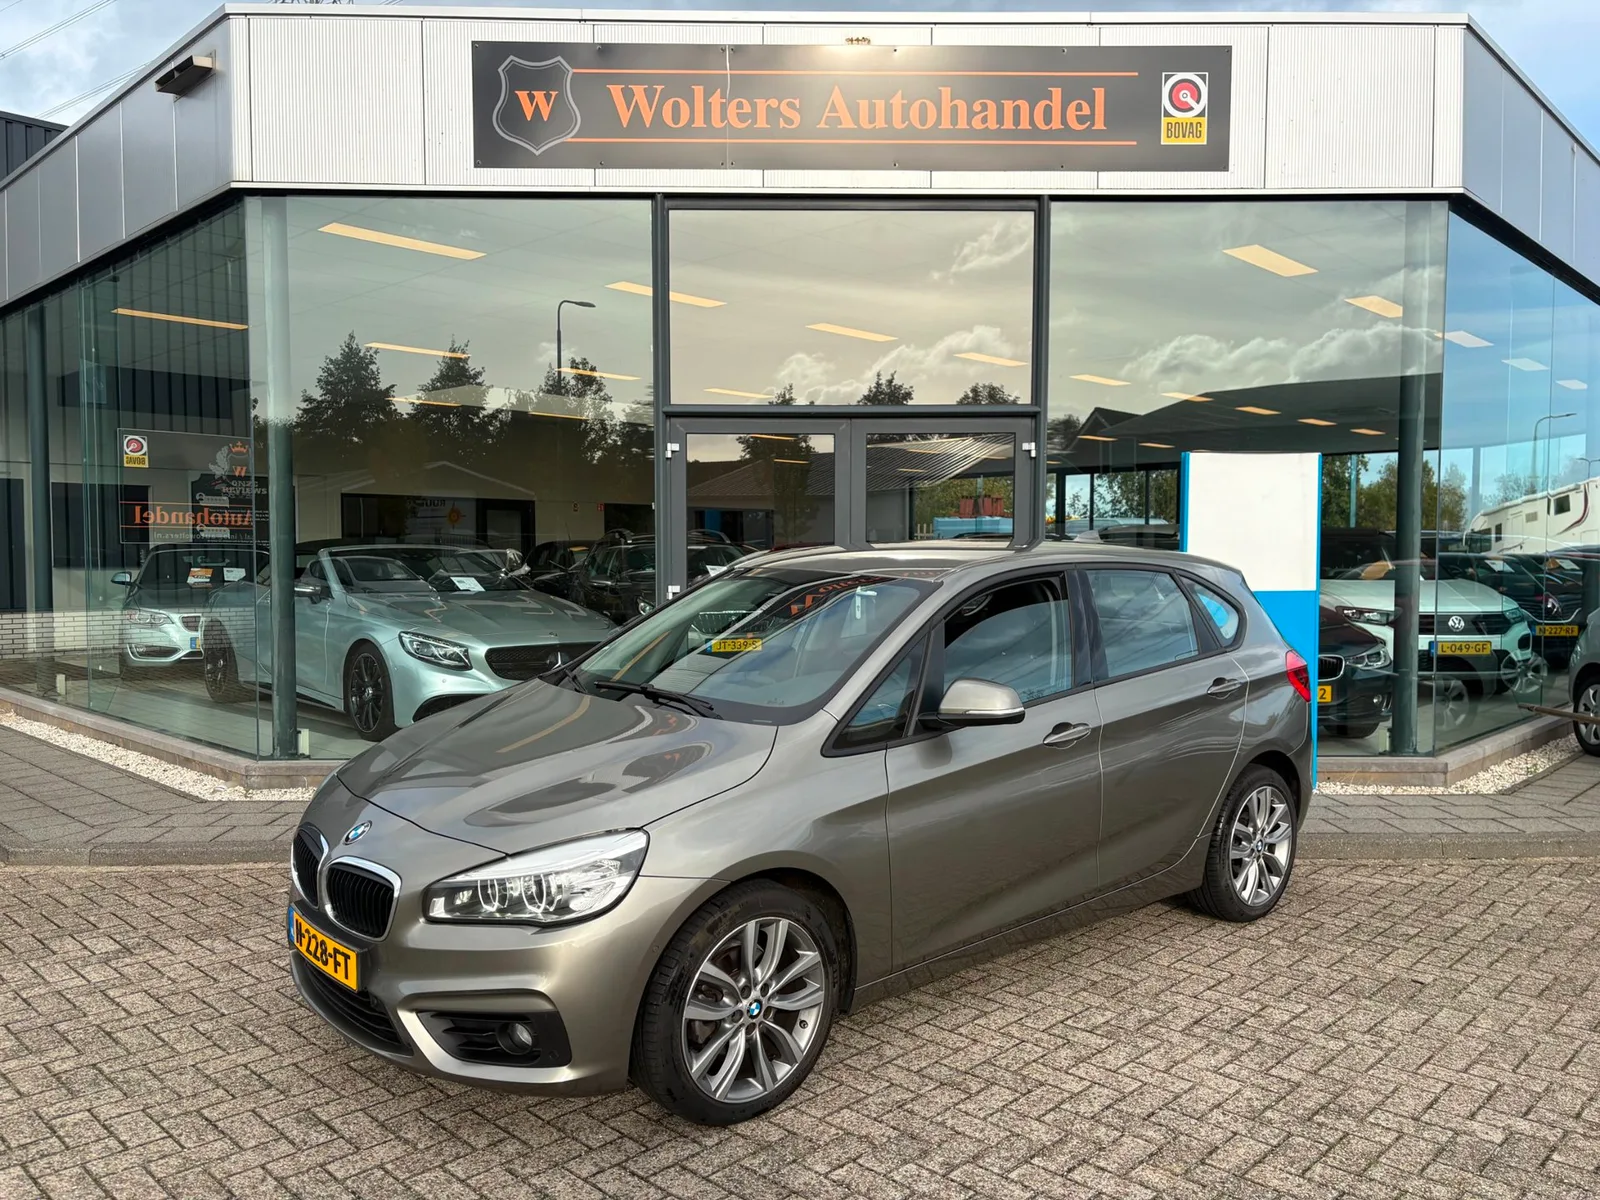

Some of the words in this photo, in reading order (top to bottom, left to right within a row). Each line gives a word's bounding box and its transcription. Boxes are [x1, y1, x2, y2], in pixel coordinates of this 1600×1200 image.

[515, 89, 557, 121] W
[607, 83, 801, 129] Wolters
[817, 85, 1107, 132] Autohandel
[1166, 121, 1203, 139] BOVAG
[1440, 643, 1488, 653] L-049-GF
[295, 917, 351, 981] N-228-FT
